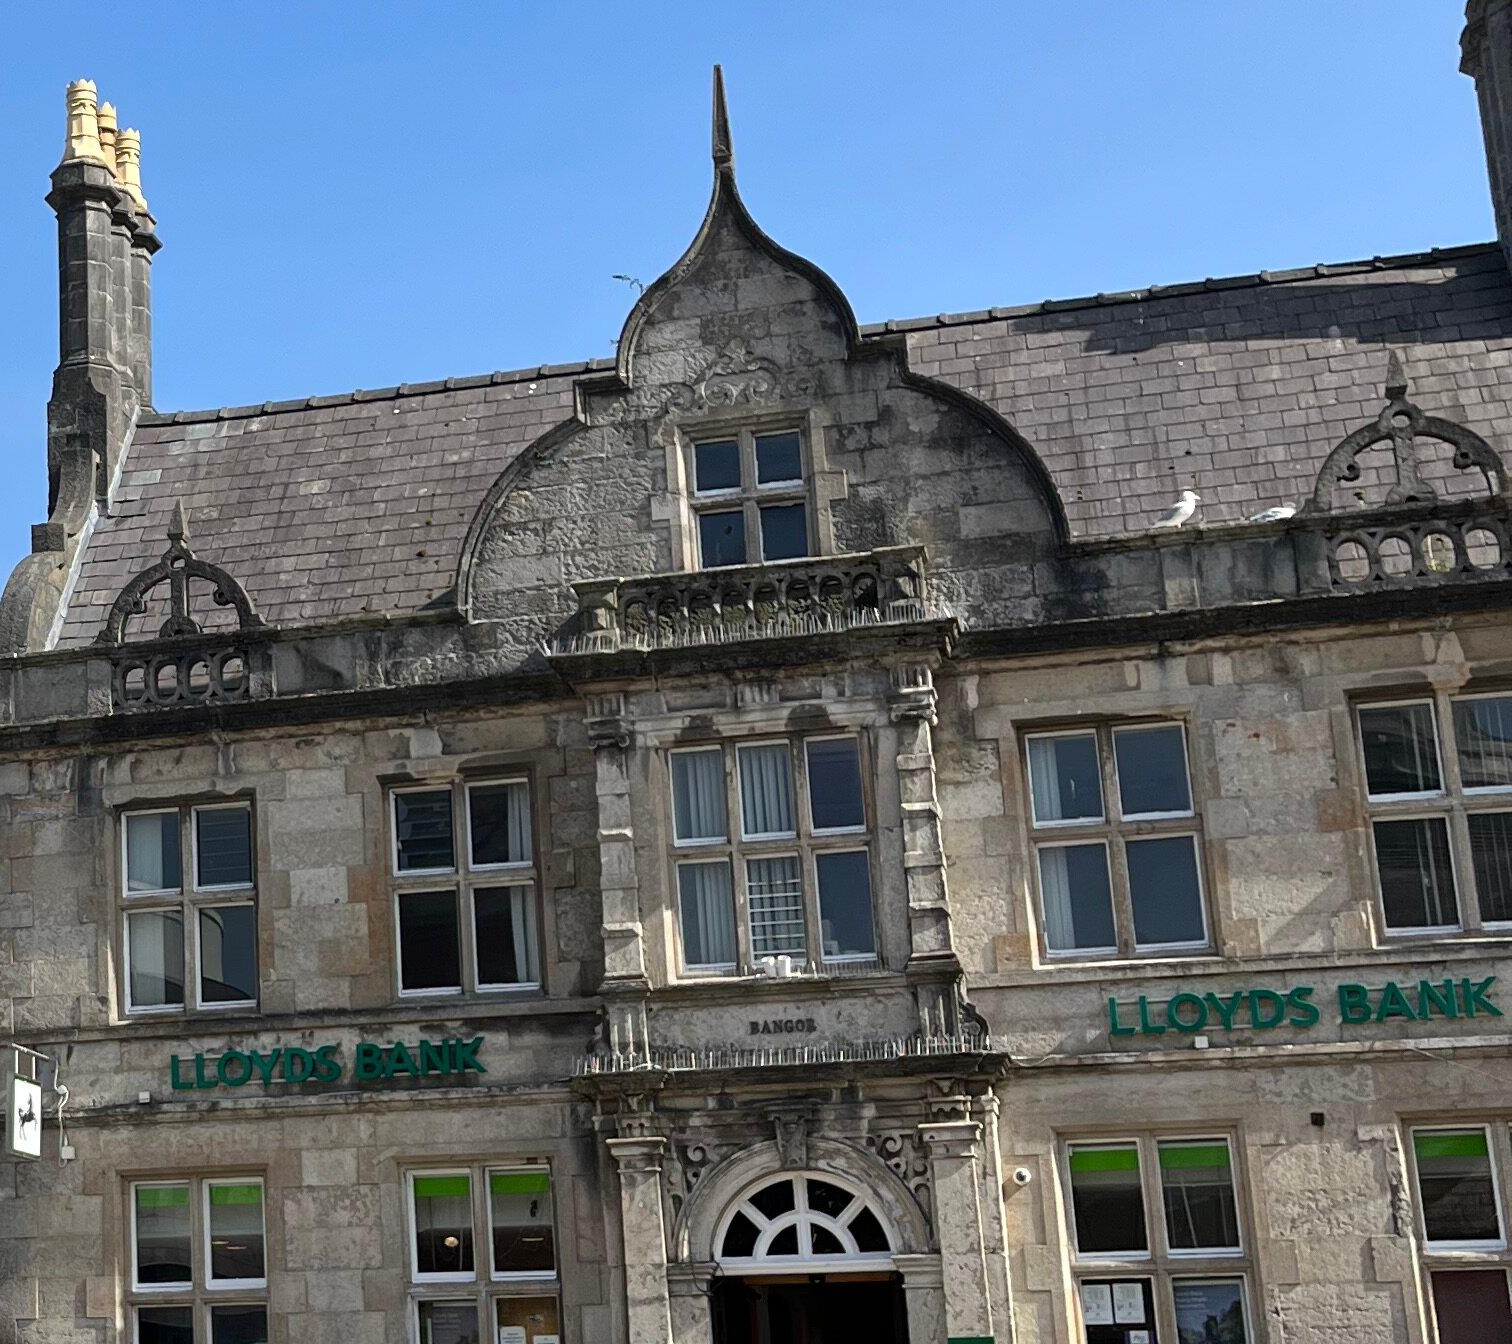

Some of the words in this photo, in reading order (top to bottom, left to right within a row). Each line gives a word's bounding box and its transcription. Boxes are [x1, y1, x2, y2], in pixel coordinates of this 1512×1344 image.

[749, 1018, 818, 1035] BANGOR
[1108, 986, 1320, 1036] LLOYDS
[1338, 975, 1504, 1024] BANK
[170, 1044, 342, 1091] LLOYDS
[355, 1036, 487, 1081] BANK
